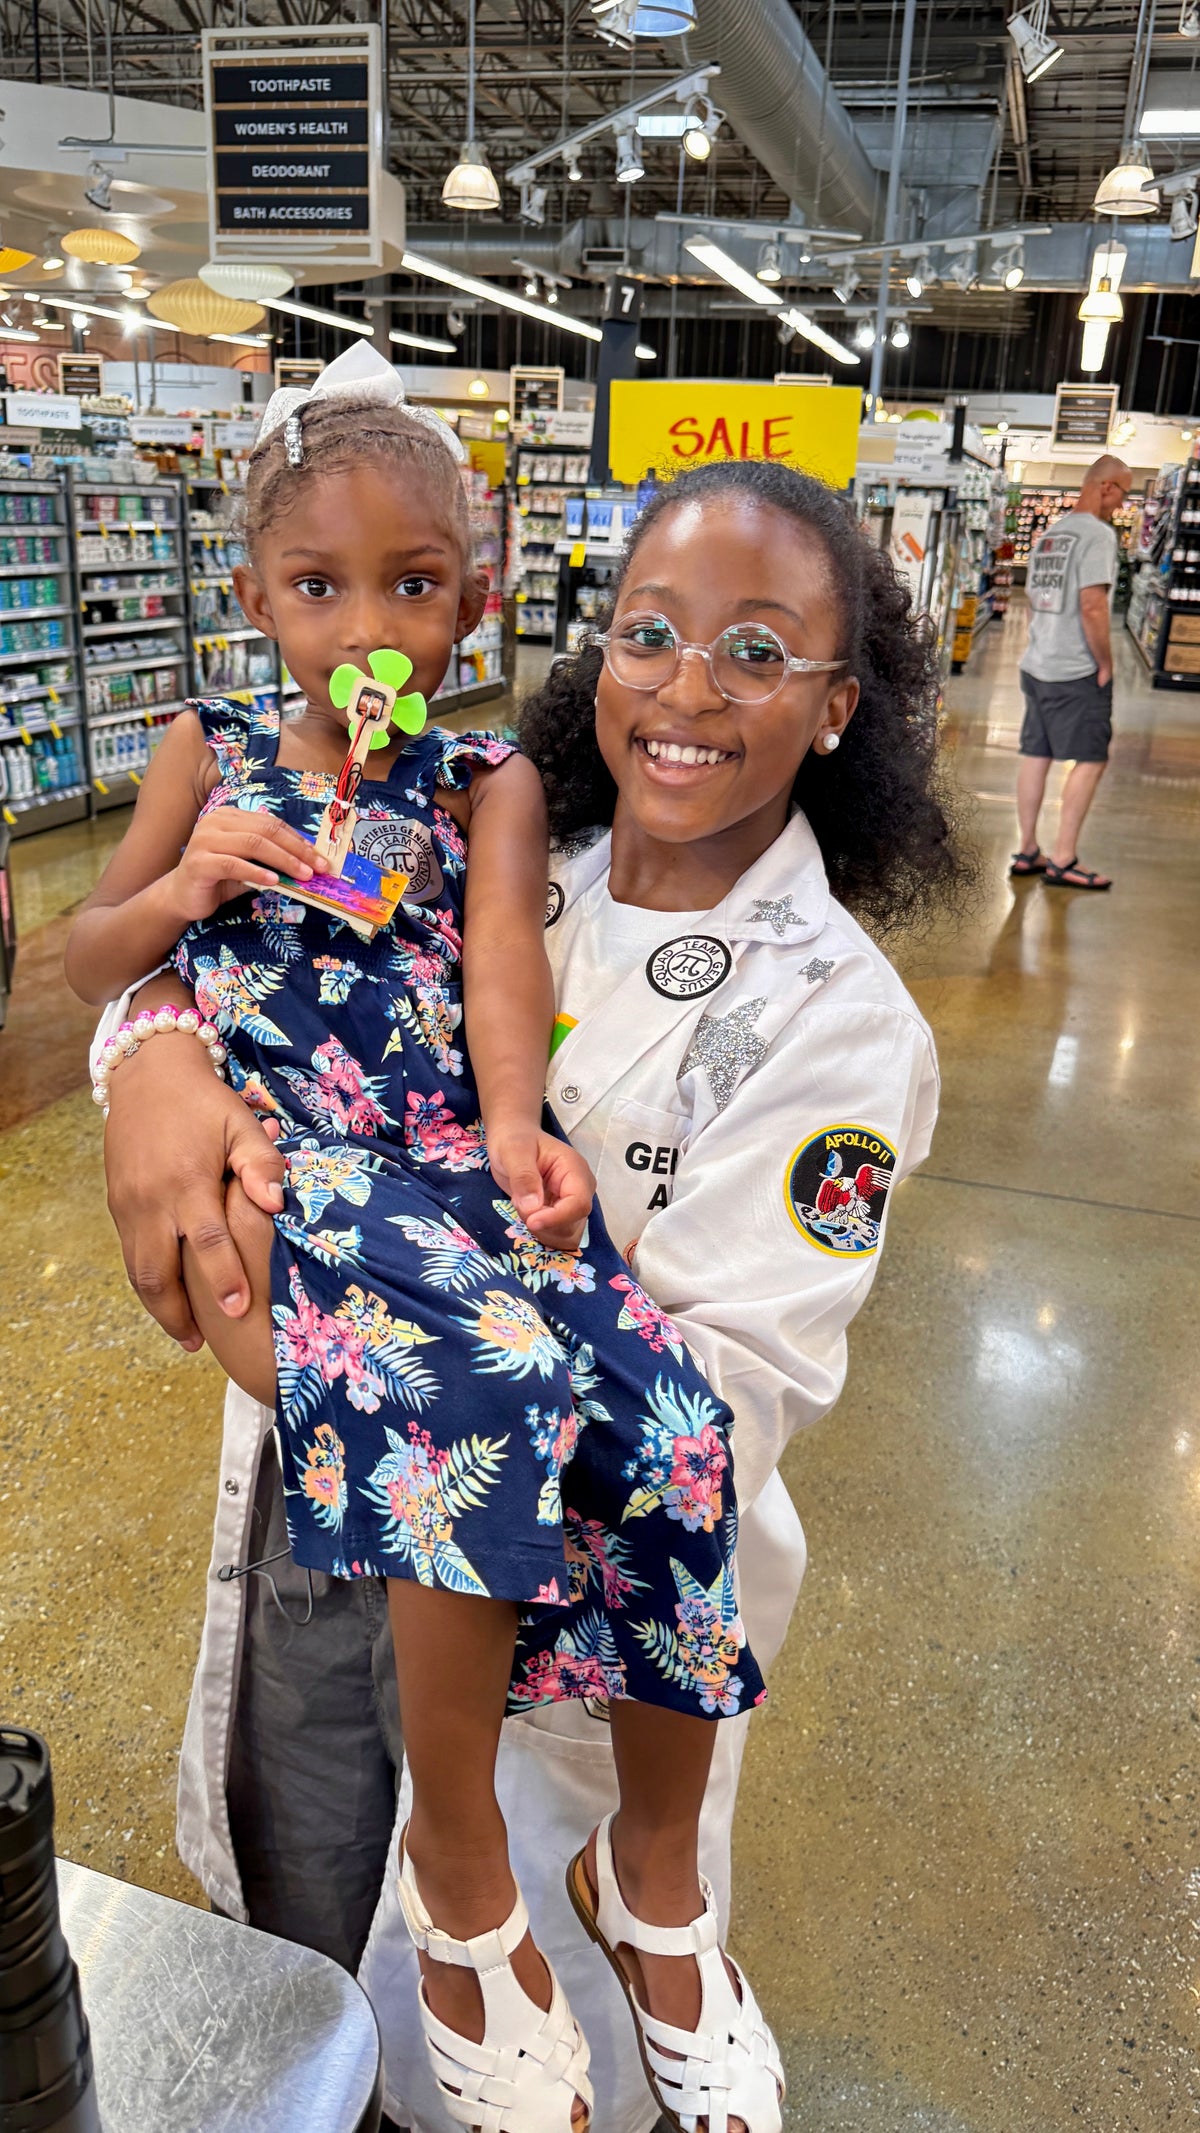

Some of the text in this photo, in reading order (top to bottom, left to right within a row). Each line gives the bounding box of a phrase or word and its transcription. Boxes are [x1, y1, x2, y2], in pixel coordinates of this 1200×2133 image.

[249, 79, 331, 92] TOOTHPASTE
[235, 122, 348, 135] WOMEN'S HEALTH
[252, 165, 331, 178] DEODORANT
[234, 207, 353, 220] BATH ACCESSORIES
[621, 286, 635, 313] 7
[17, 408, 70, 420] TOOTHPASTE
[668, 416, 794, 460] SALE
[357, 823, 434, 857] CERTIFIED GENIUS
[376, 835, 429, 891] TEAM GENIUS
[682, 940, 721, 956] TEAM
[653, 949, 674, 987] SQUAD
[679, 961, 724, 993] GENIUS
[825, 1132, 881, 1154] APOLLO
